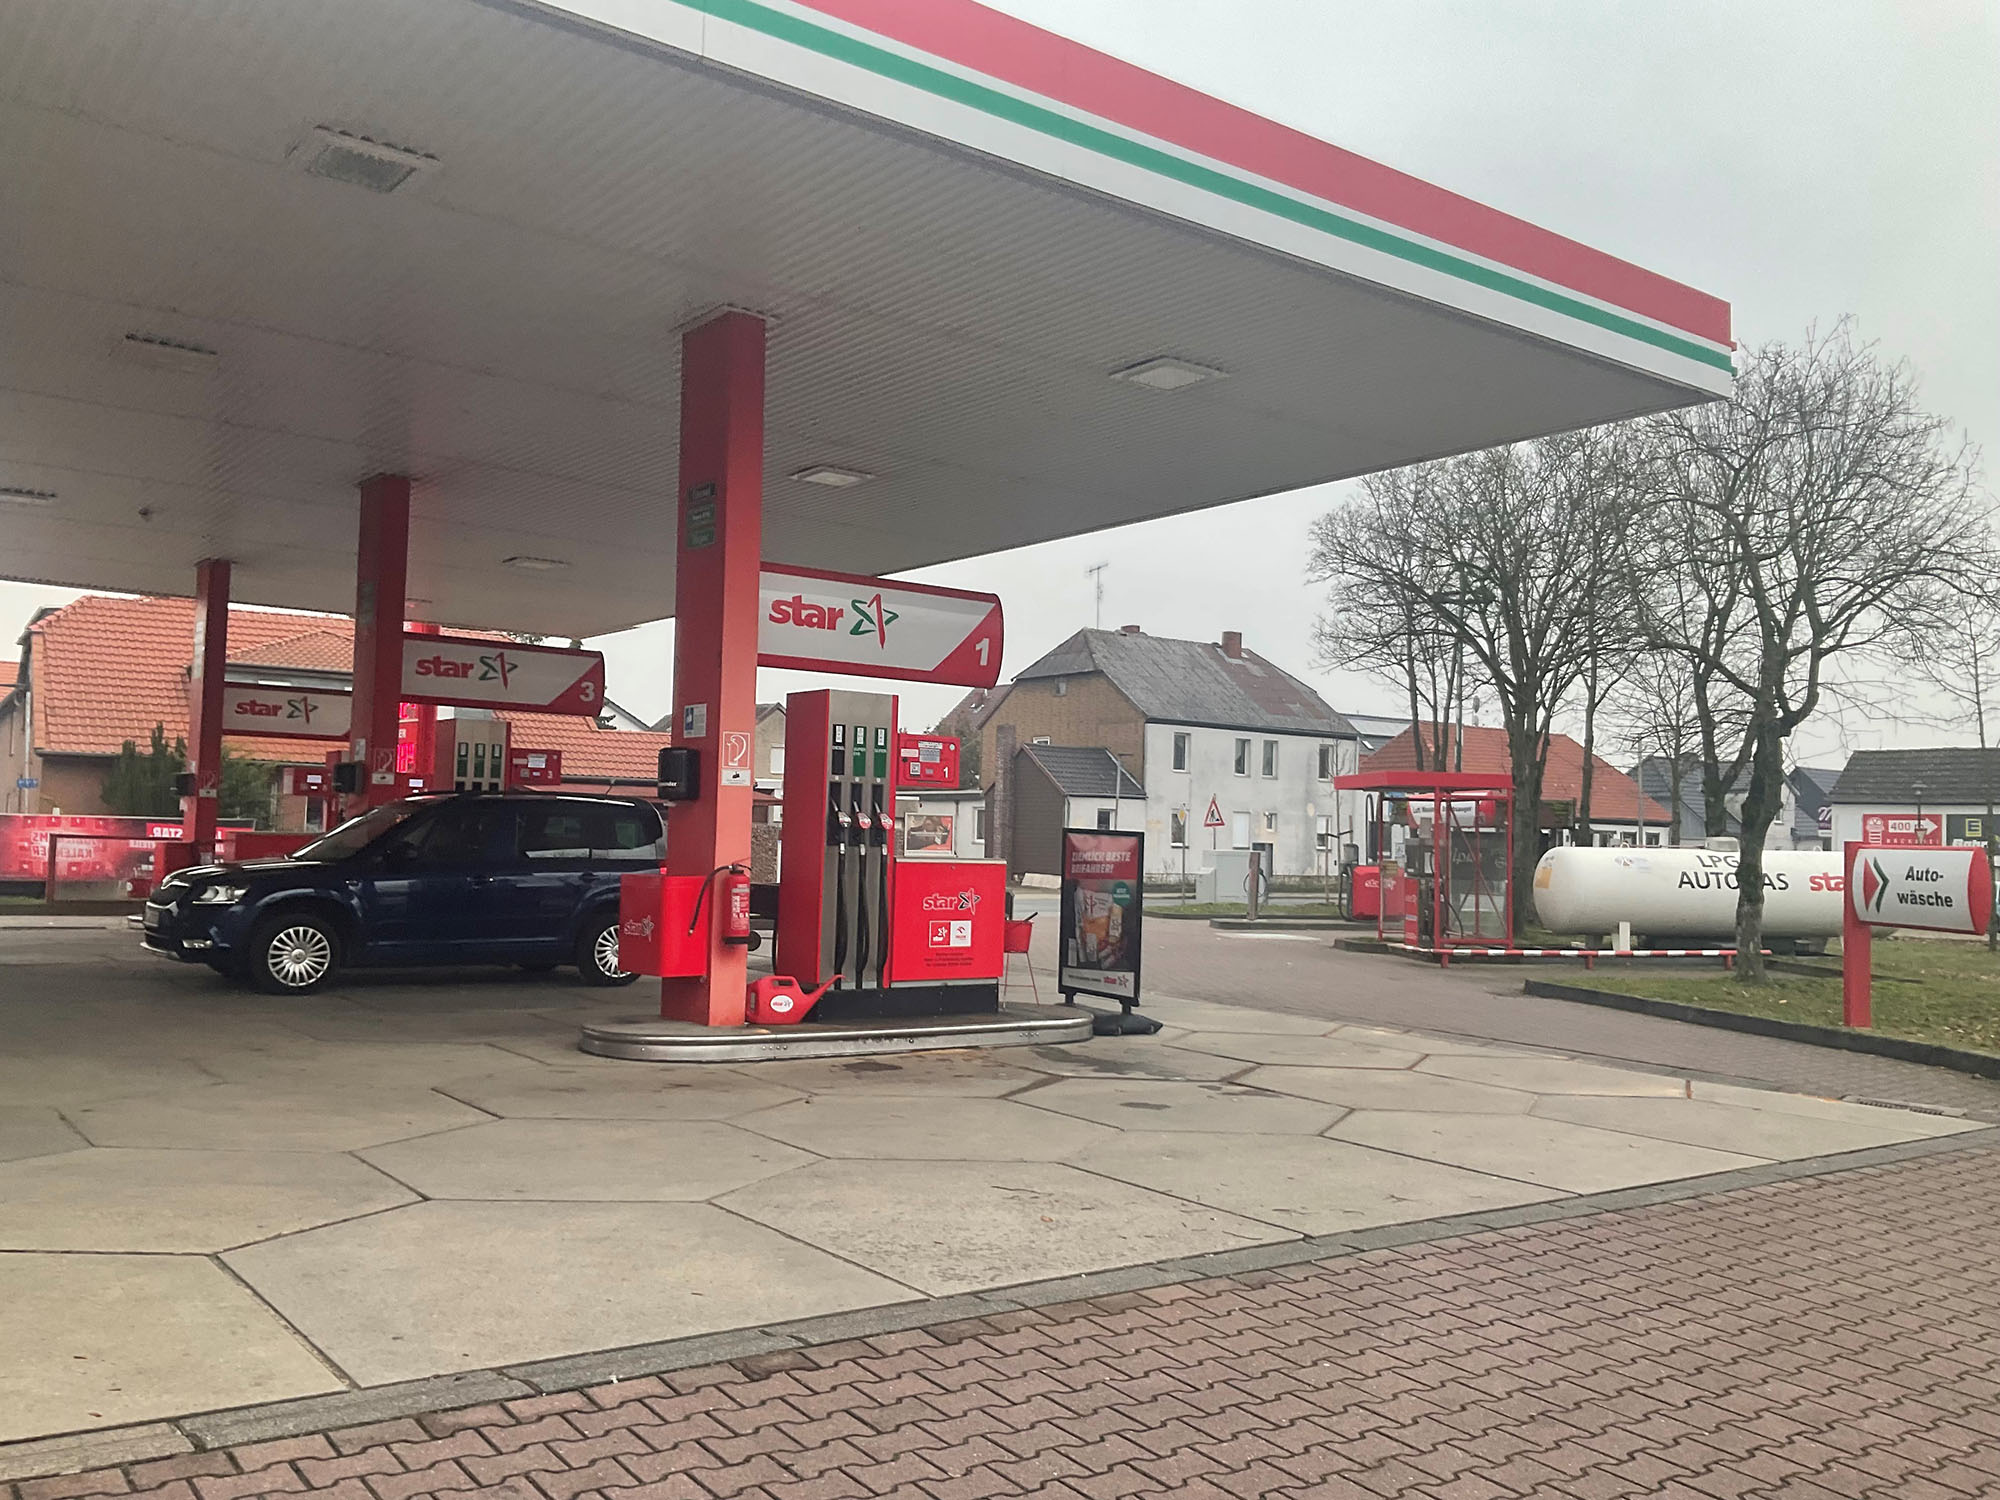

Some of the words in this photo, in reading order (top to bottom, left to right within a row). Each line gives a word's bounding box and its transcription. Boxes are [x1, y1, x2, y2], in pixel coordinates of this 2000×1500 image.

[769, 595, 844, 631] star
[975, 637, 990, 666] 1
[415, 655, 474, 678] star
[579, 681, 595, 702] 3
[235, 699, 283, 717] star
[943, 766, 949, 779] 1
[1890, 822, 1911, 831] 400
[1105, 851, 1132, 863] BESTE
[1695, 854, 1740, 869] LPG
[1677, 871, 1789, 890] AUTOAS
[1809, 872, 1844, 892] sta
[1904, 866, 1944, 882] Auto-
[922, 892, 958, 911] star
[1897, 890, 1953, 908] wäsche
